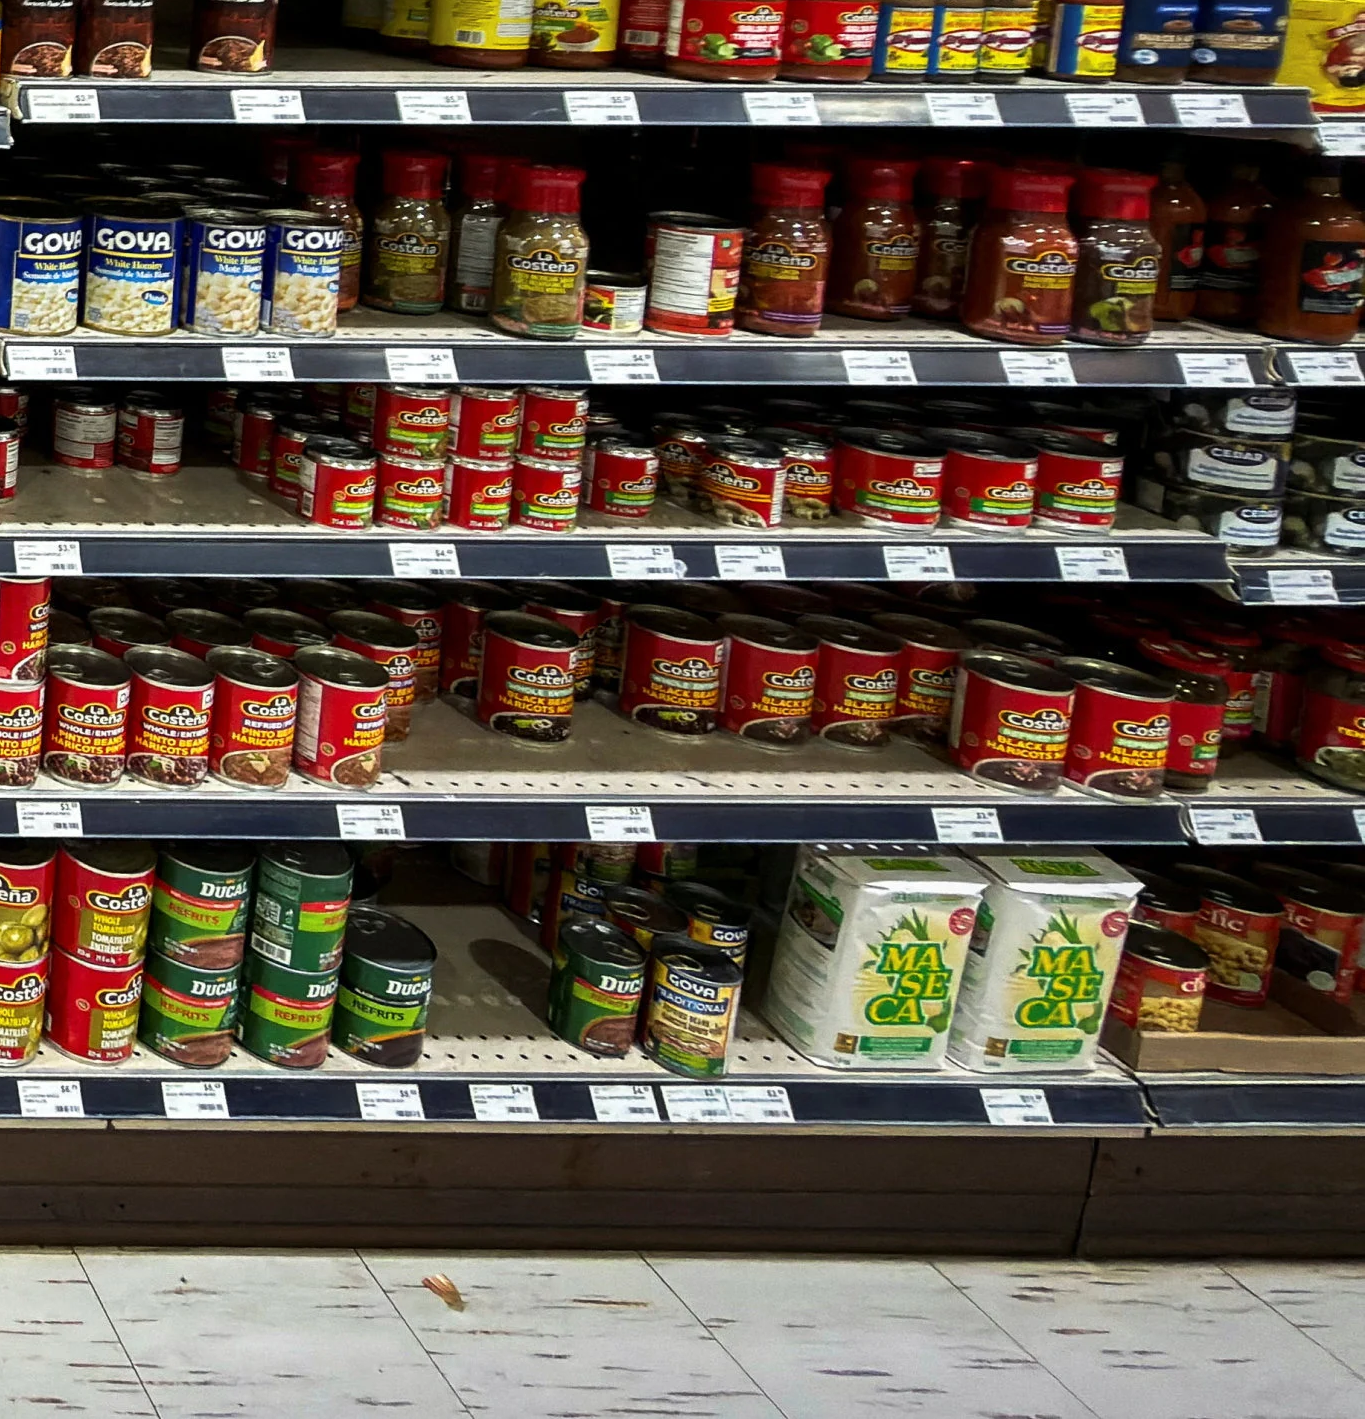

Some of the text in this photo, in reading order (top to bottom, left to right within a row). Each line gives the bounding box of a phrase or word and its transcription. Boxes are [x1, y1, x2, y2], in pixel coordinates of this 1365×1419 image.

[97, 228, 170, 251] GOYA
[105, 258, 162, 270] White Hominy
[511, 257, 575, 272] Costeña
[18, 709, 31, 717] La
[63, 708, 123, 724] Costeña
[90, 706, 104, 715] La
[148, 710, 207, 726] Costeña
[175, 707, 190, 716] La
[59, 730, 123, 746] PINTO BEANS
[144, 731, 177, 746] PINTO
[242, 727, 274, 738] PINTO
[52, 734, 104, 754] HARICOTS
[998, 735, 1042, 752] BLACK
[128, 887, 143, 898] La
[93, 913, 121, 925] WHOLE
[169, 903, 220, 926] REFRITS
[881, 945, 944, 974] MA
[1033, 947, 1095, 978] MA
[669, 973, 716, 998] GOYA
[899, 973, 949, 999] SE
[1049, 976, 1101, 1002] SE
[656, 987, 725, 1013] TRADITIONAL
[274, 1007, 323, 1024] REFRITS
[352, 999, 404, 1021] REFRITS
[869, 1000, 925, 1025] CA
[1020, 1003, 1074, 1028] CA
